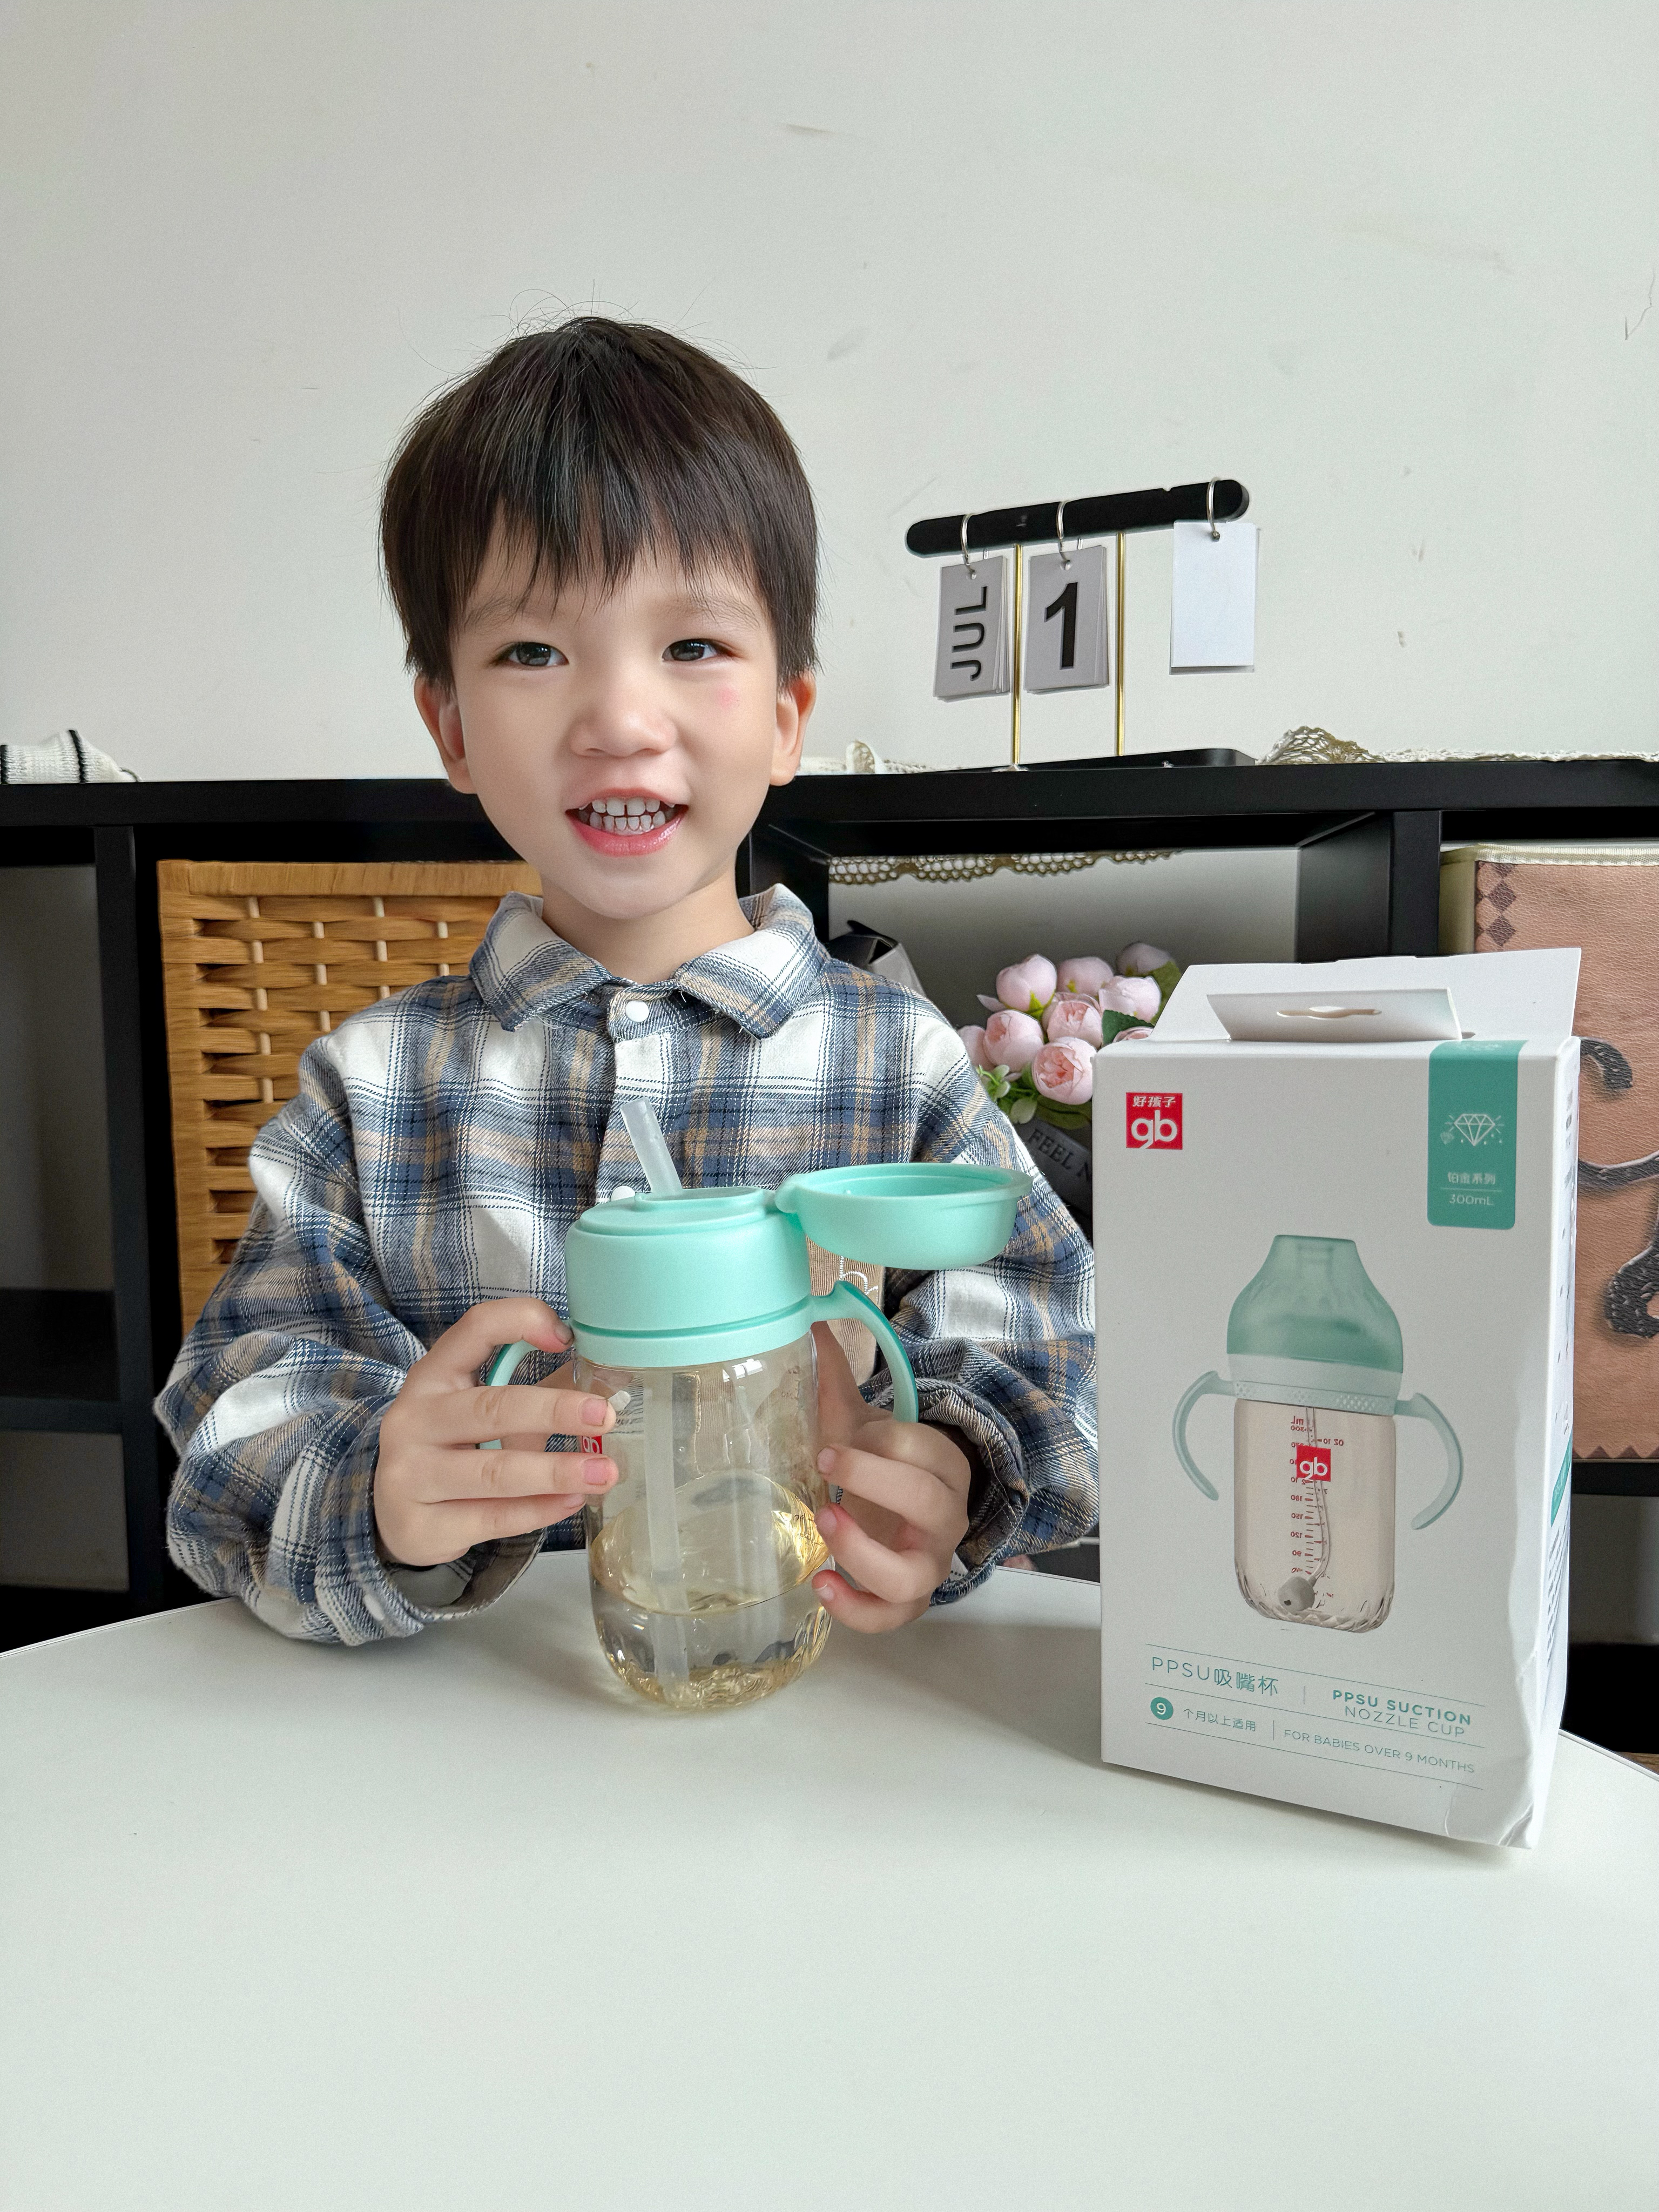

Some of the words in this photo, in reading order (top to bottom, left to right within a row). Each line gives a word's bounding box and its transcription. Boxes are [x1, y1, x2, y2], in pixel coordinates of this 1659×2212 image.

[949, 586, 988, 682] JUL
[1043, 581, 1078, 670] 1
[1132, 1095, 1176, 1108] 好孩子
[1131, 1109, 1178, 1150] gb
[1028, 1128, 1075, 1170] FEEL
[1449, 1193, 1494, 1206] 300mL
[1299, 1456, 1328, 1481] gb
[1152, 1656, 1279, 1697] PPSU吸嘴杯
[1156, 1702, 1166, 1716] 9
[1182, 1708, 1257, 1732] 个月以上适用
[1332, 1689, 1379, 1708] PPSU
[1386, 1699, 1472, 1726] SUCTION
[1344, 1705, 1419, 1729] NOZZLE
[1427, 1721, 1465, 1738] CUP
[1284, 1729, 1310, 1743] FOR
[1313, 1735, 1360, 1752] BABIES
[1364, 1744, 1401, 1759] OVER
[1405, 1752, 1413, 1761] 9
[1417, 1754, 1475, 1773] MONTHS
